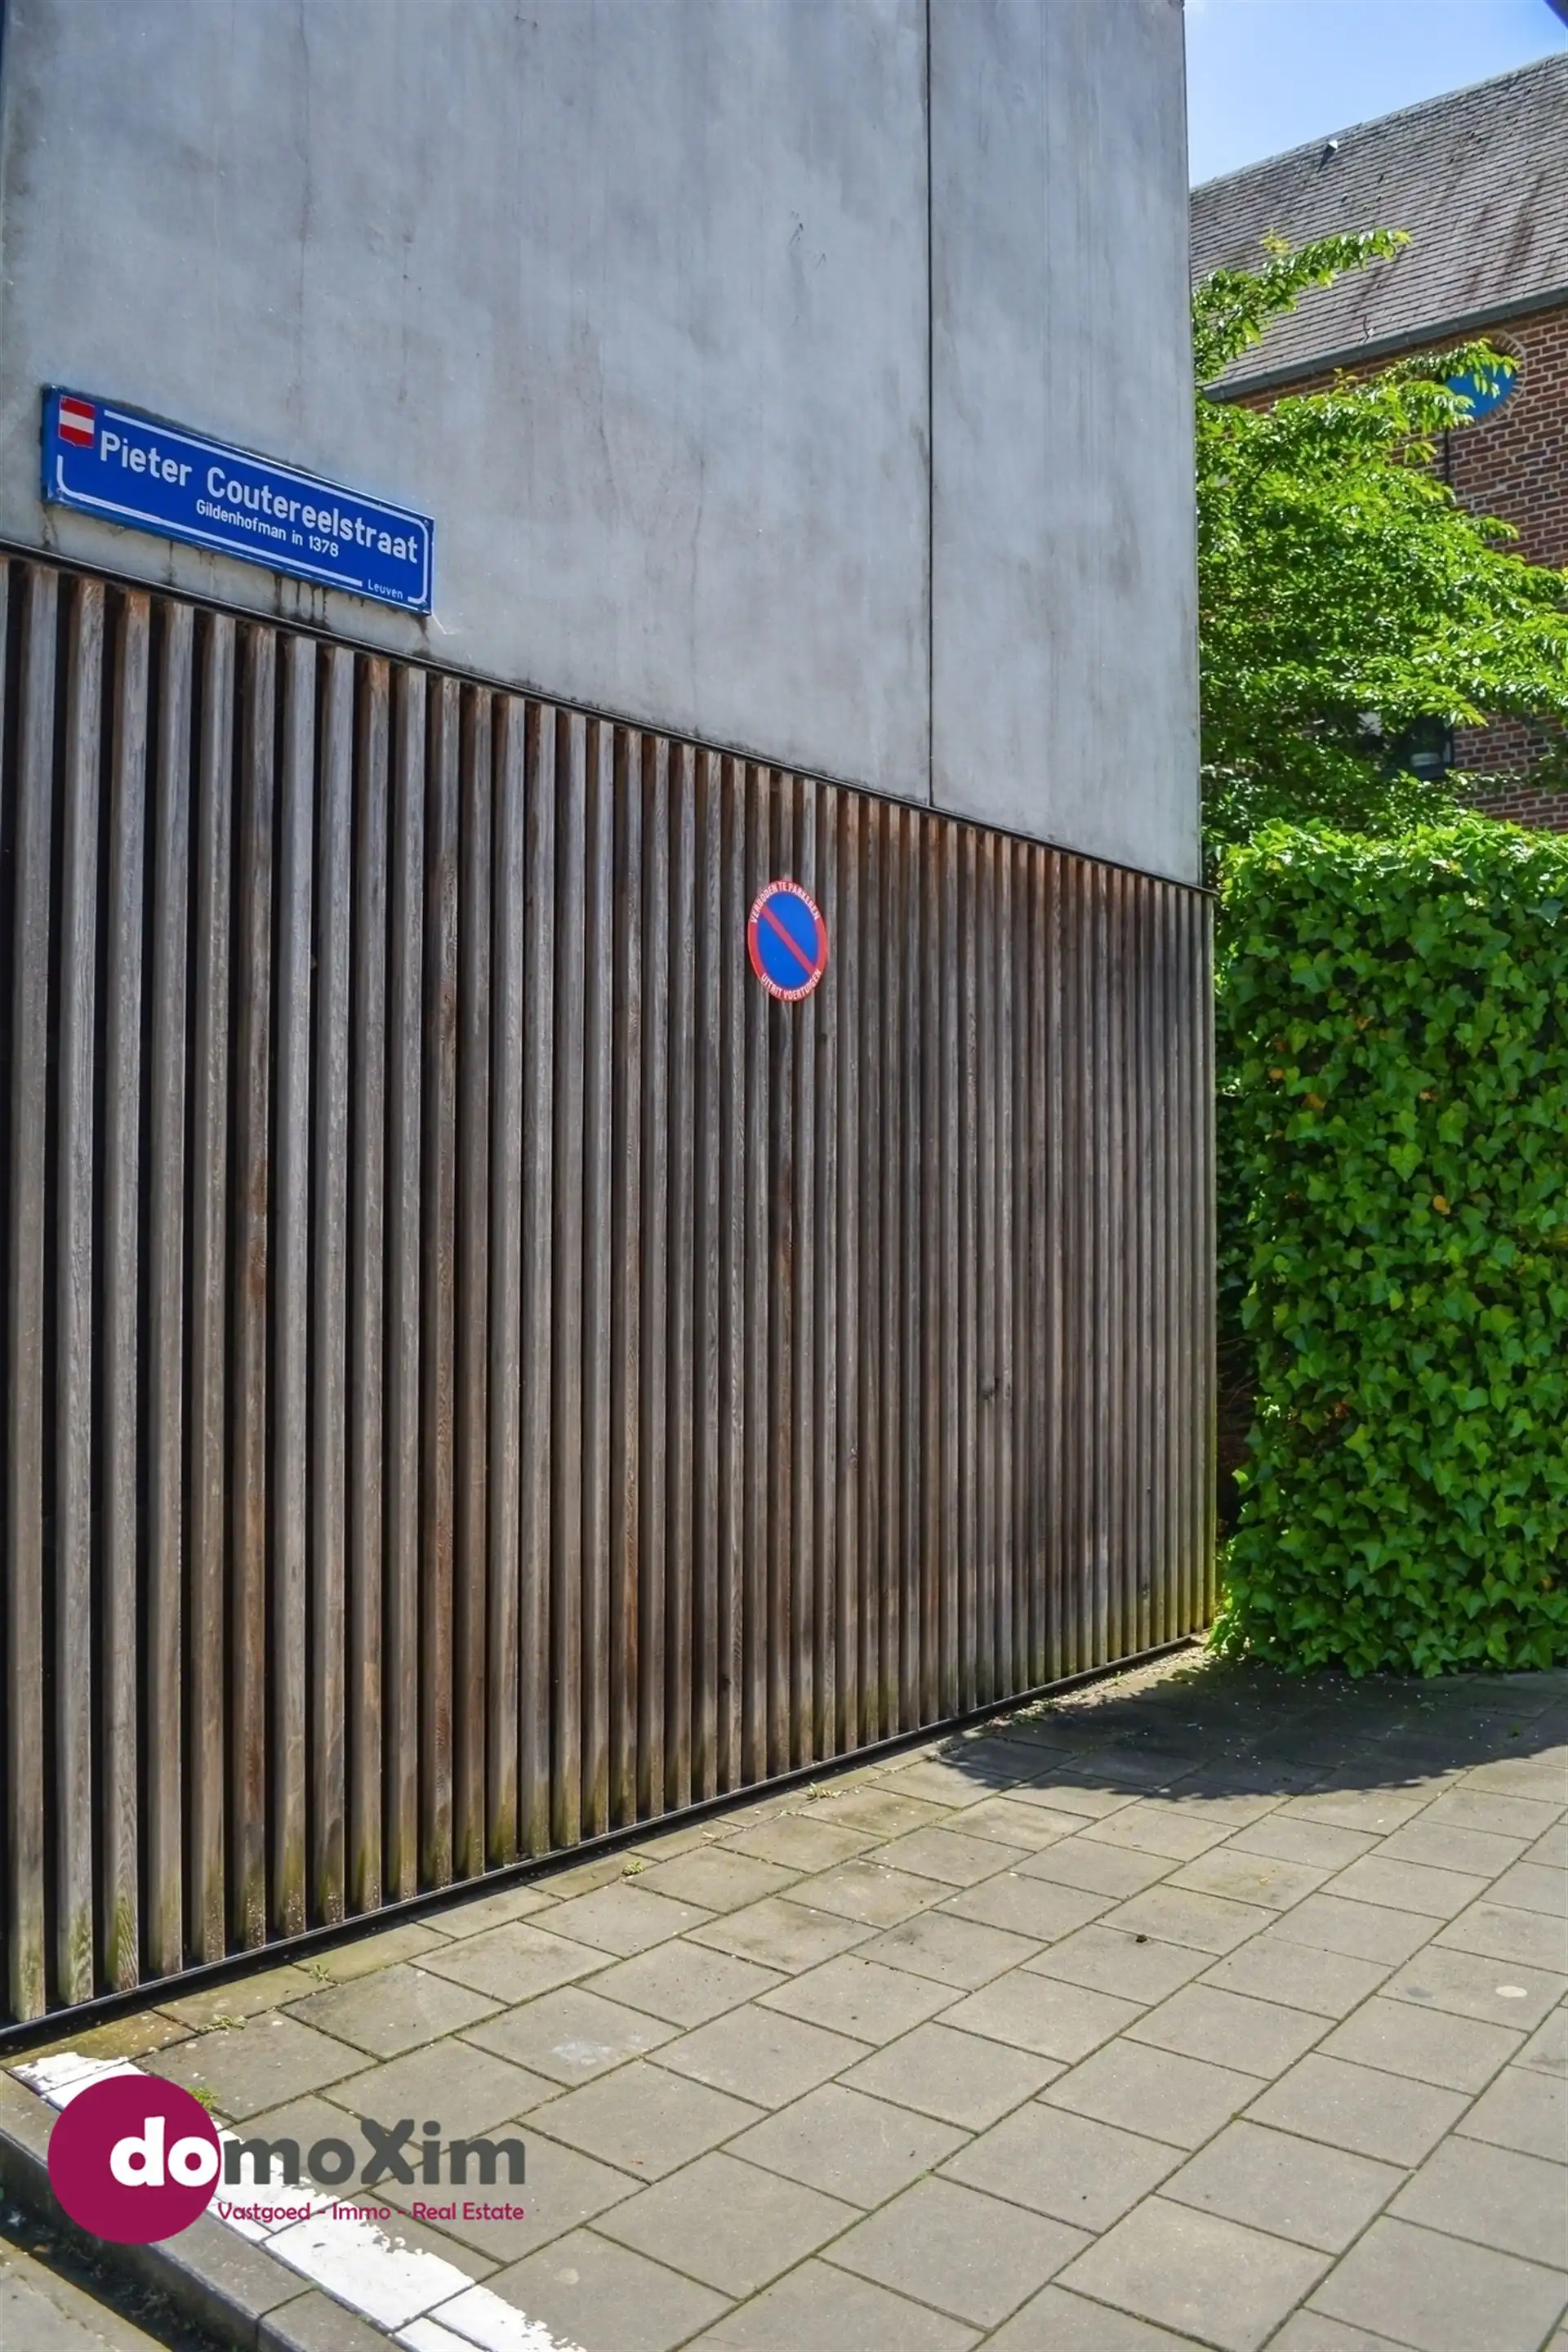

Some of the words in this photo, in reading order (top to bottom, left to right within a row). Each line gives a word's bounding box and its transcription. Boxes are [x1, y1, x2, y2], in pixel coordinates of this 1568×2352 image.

[100, 430, 192, 487] Pieter
[207, 466, 419, 564] Coutereelstraat
[195, 499, 287, 541] Gildenhofman
[292, 529, 304, 546] in
[309, 535, 340, 558] 1378
[367, 579, 404, 600] Leuven
[750, 883, 777, 923] VERBODEN
[777, 882, 788, 891] TE
[787, 882, 822, 921] PARKEREN
